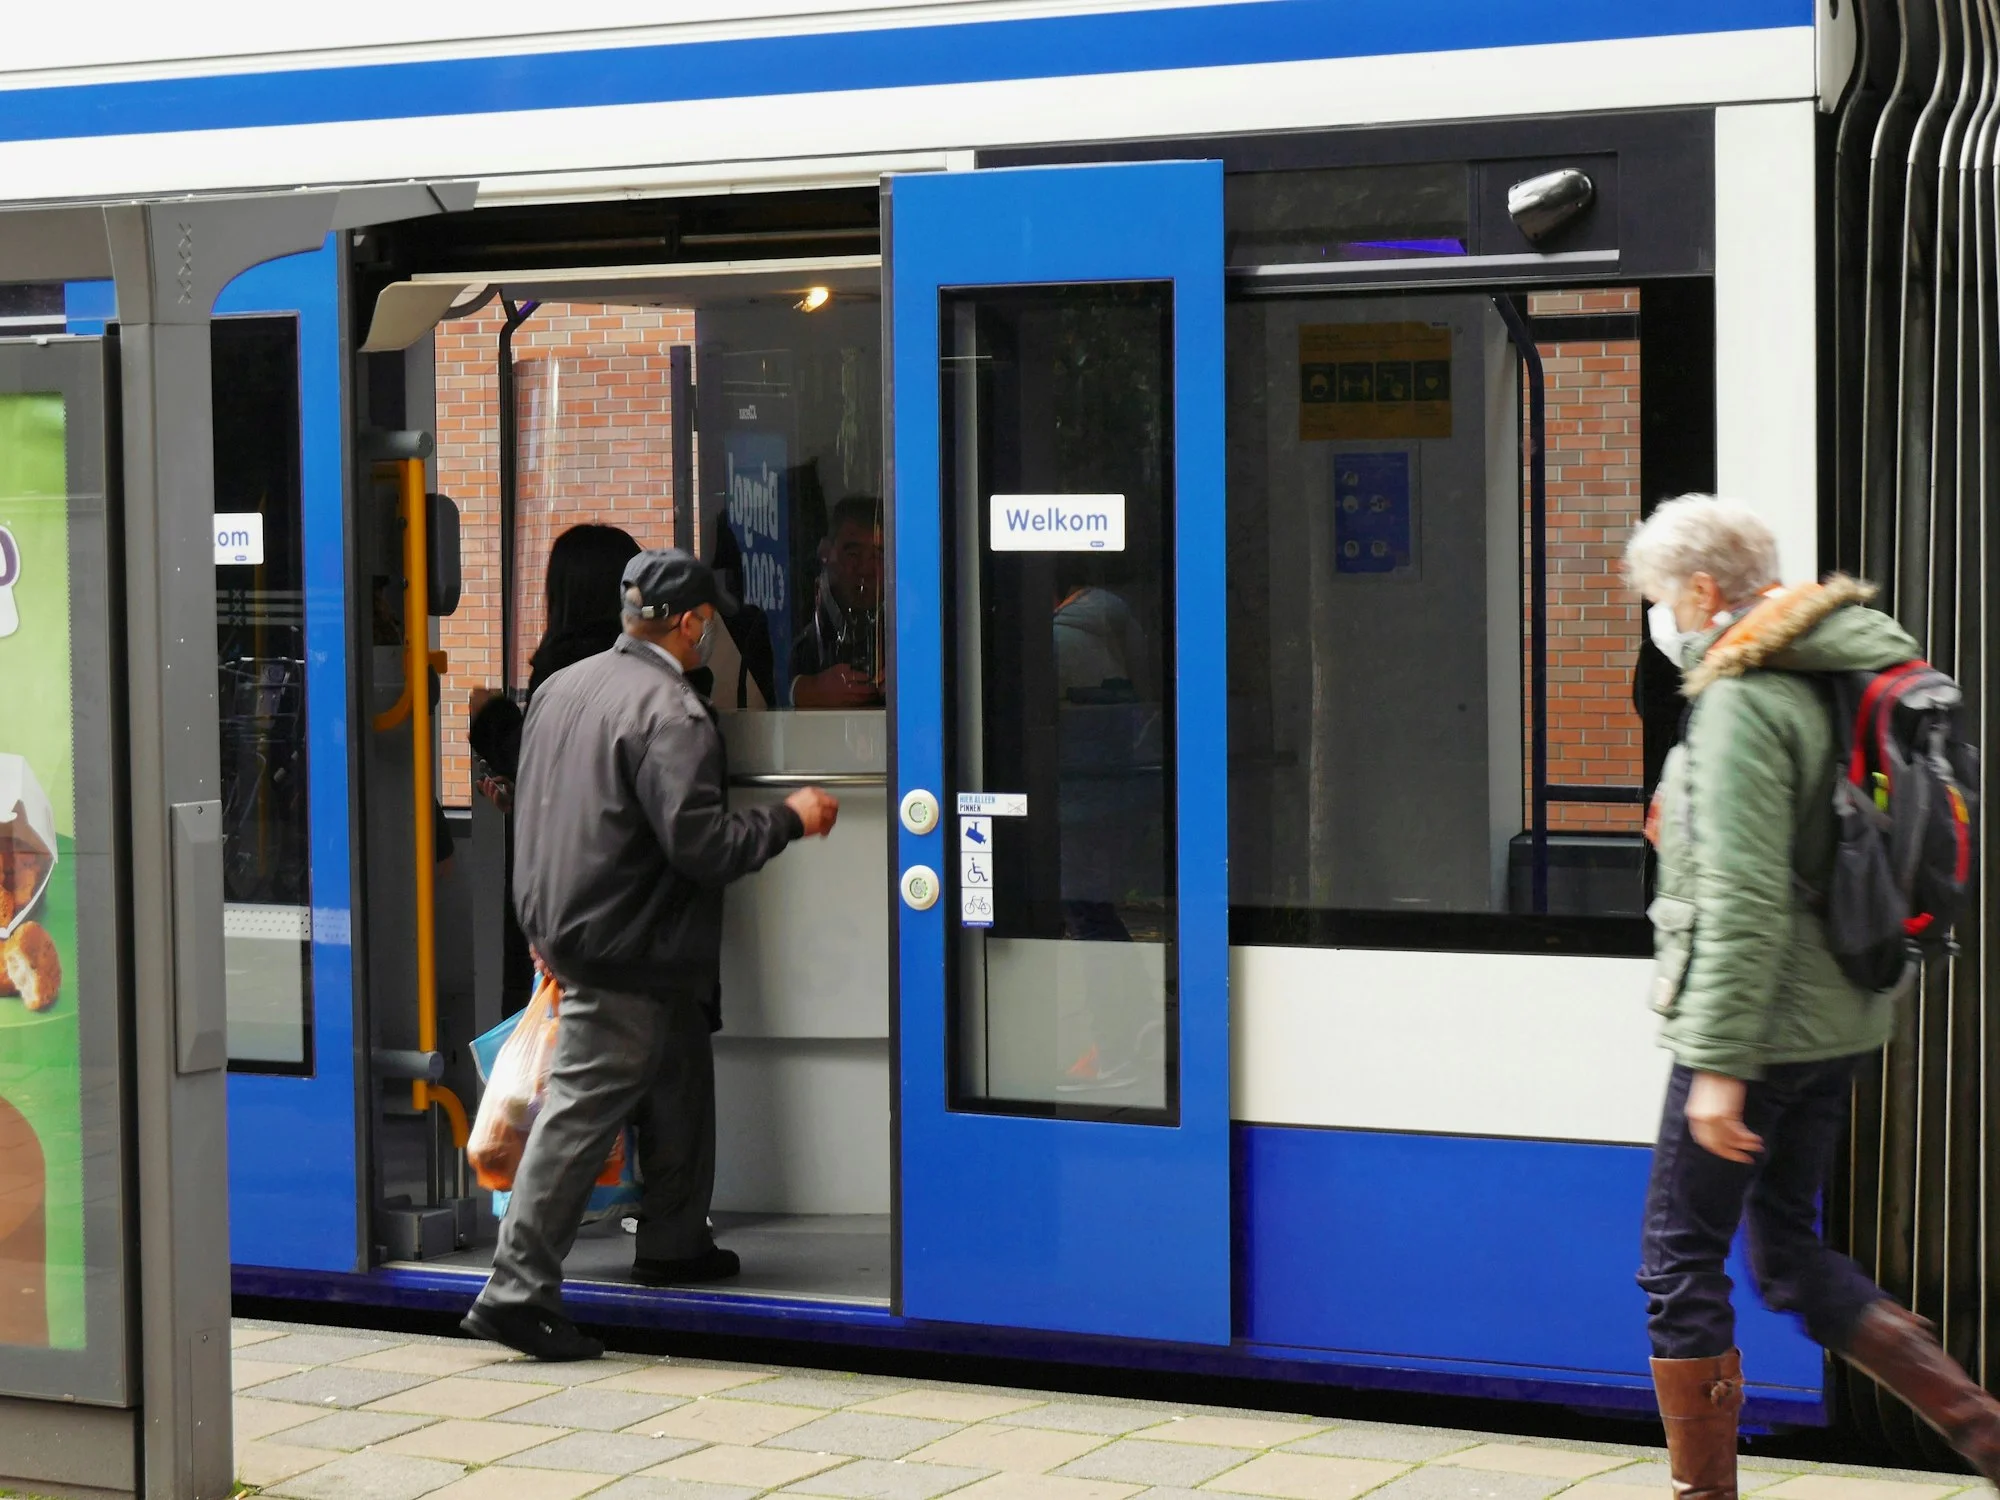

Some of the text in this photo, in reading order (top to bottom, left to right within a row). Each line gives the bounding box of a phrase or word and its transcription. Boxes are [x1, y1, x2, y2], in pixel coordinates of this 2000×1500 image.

[1006, 507, 1108, 532] Welkom
[215, 531, 249, 547] om
[974, 795, 996, 804] ALLEEN
[959, 804, 981, 812] PINNEN
